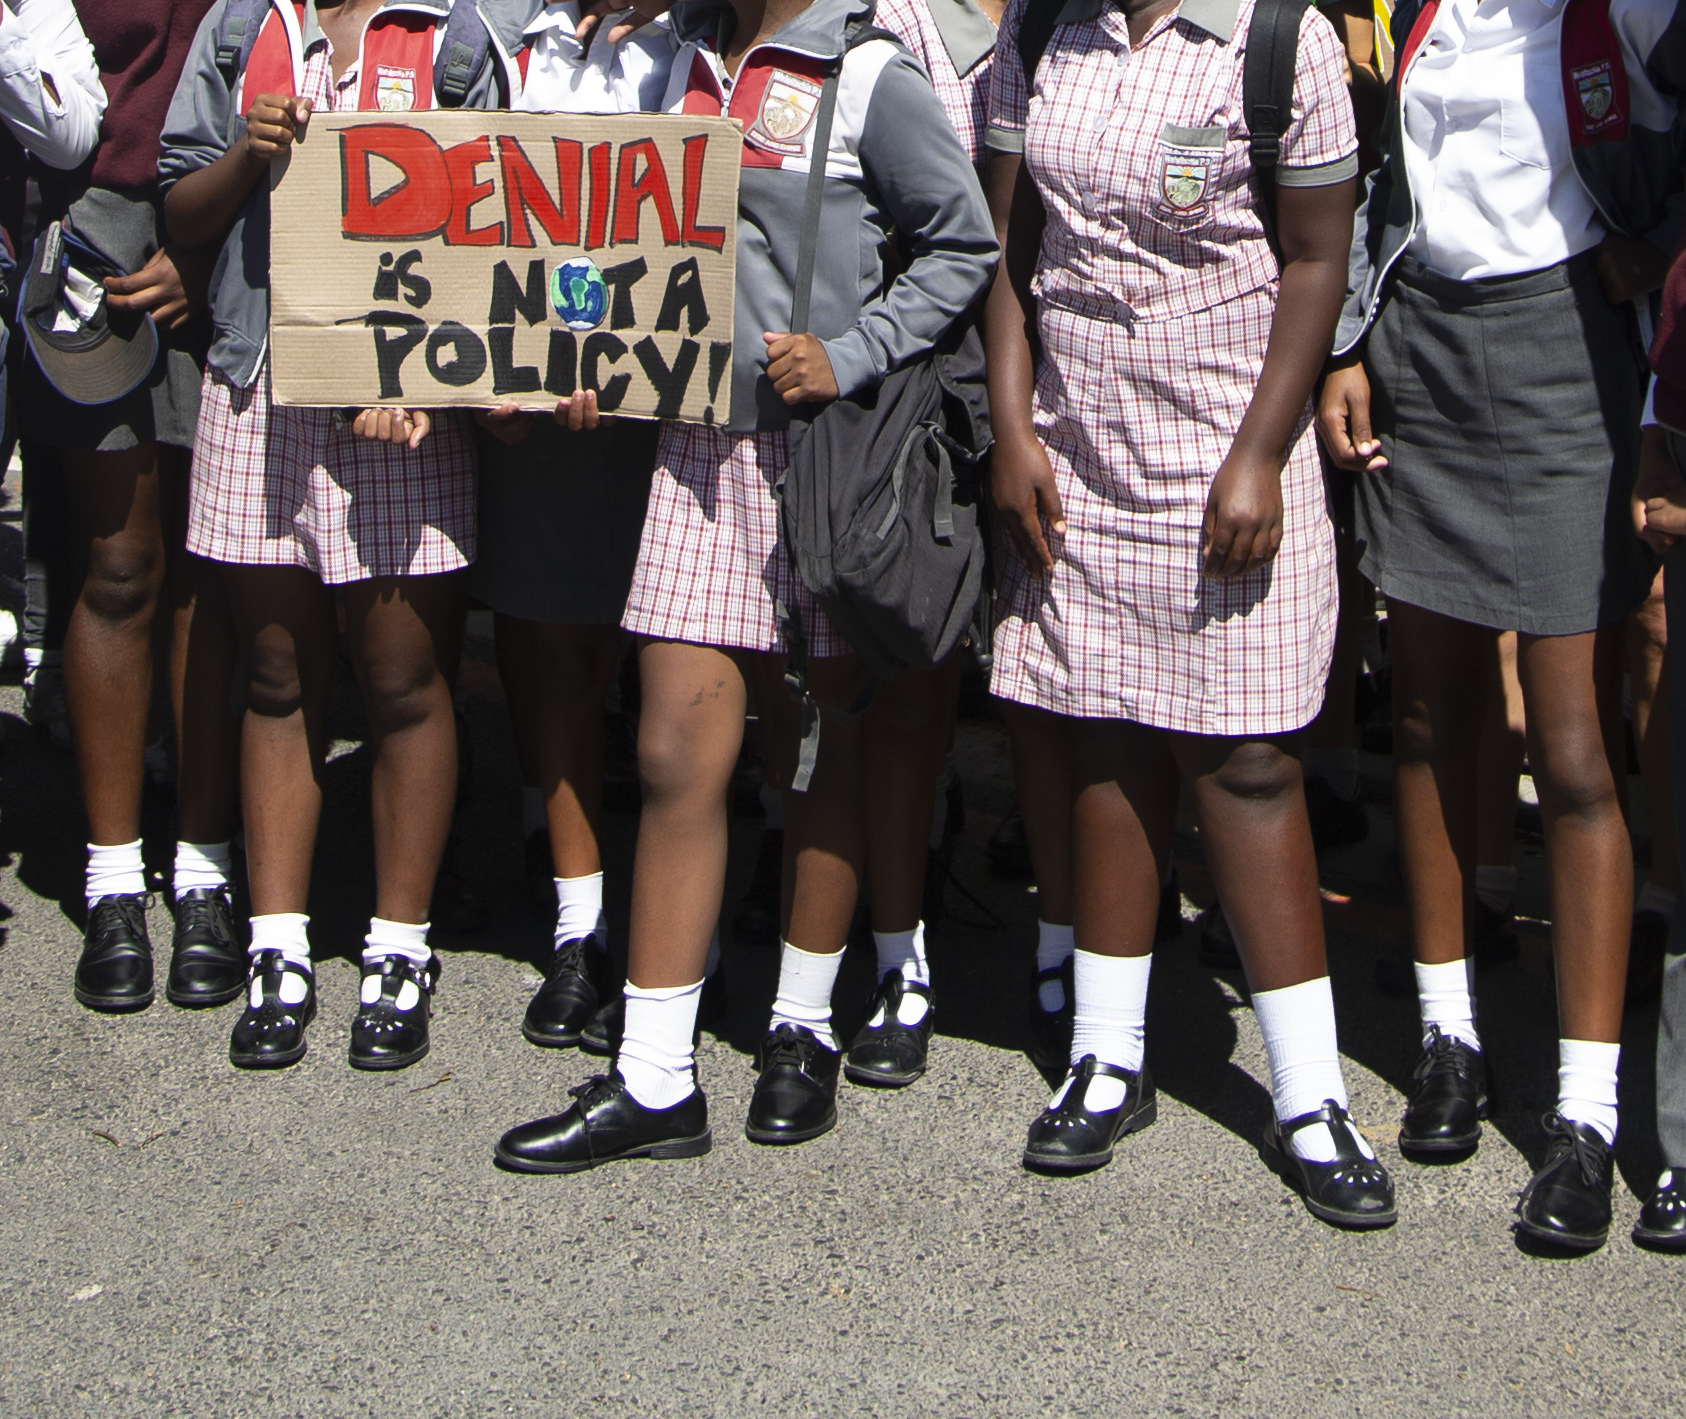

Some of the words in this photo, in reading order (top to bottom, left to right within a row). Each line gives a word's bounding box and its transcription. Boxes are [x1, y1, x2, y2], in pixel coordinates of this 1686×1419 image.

[326, 122, 727, 253] DENIAL
[654, 256, 711, 337] A
[335, 310, 732, 424] POLICY!
